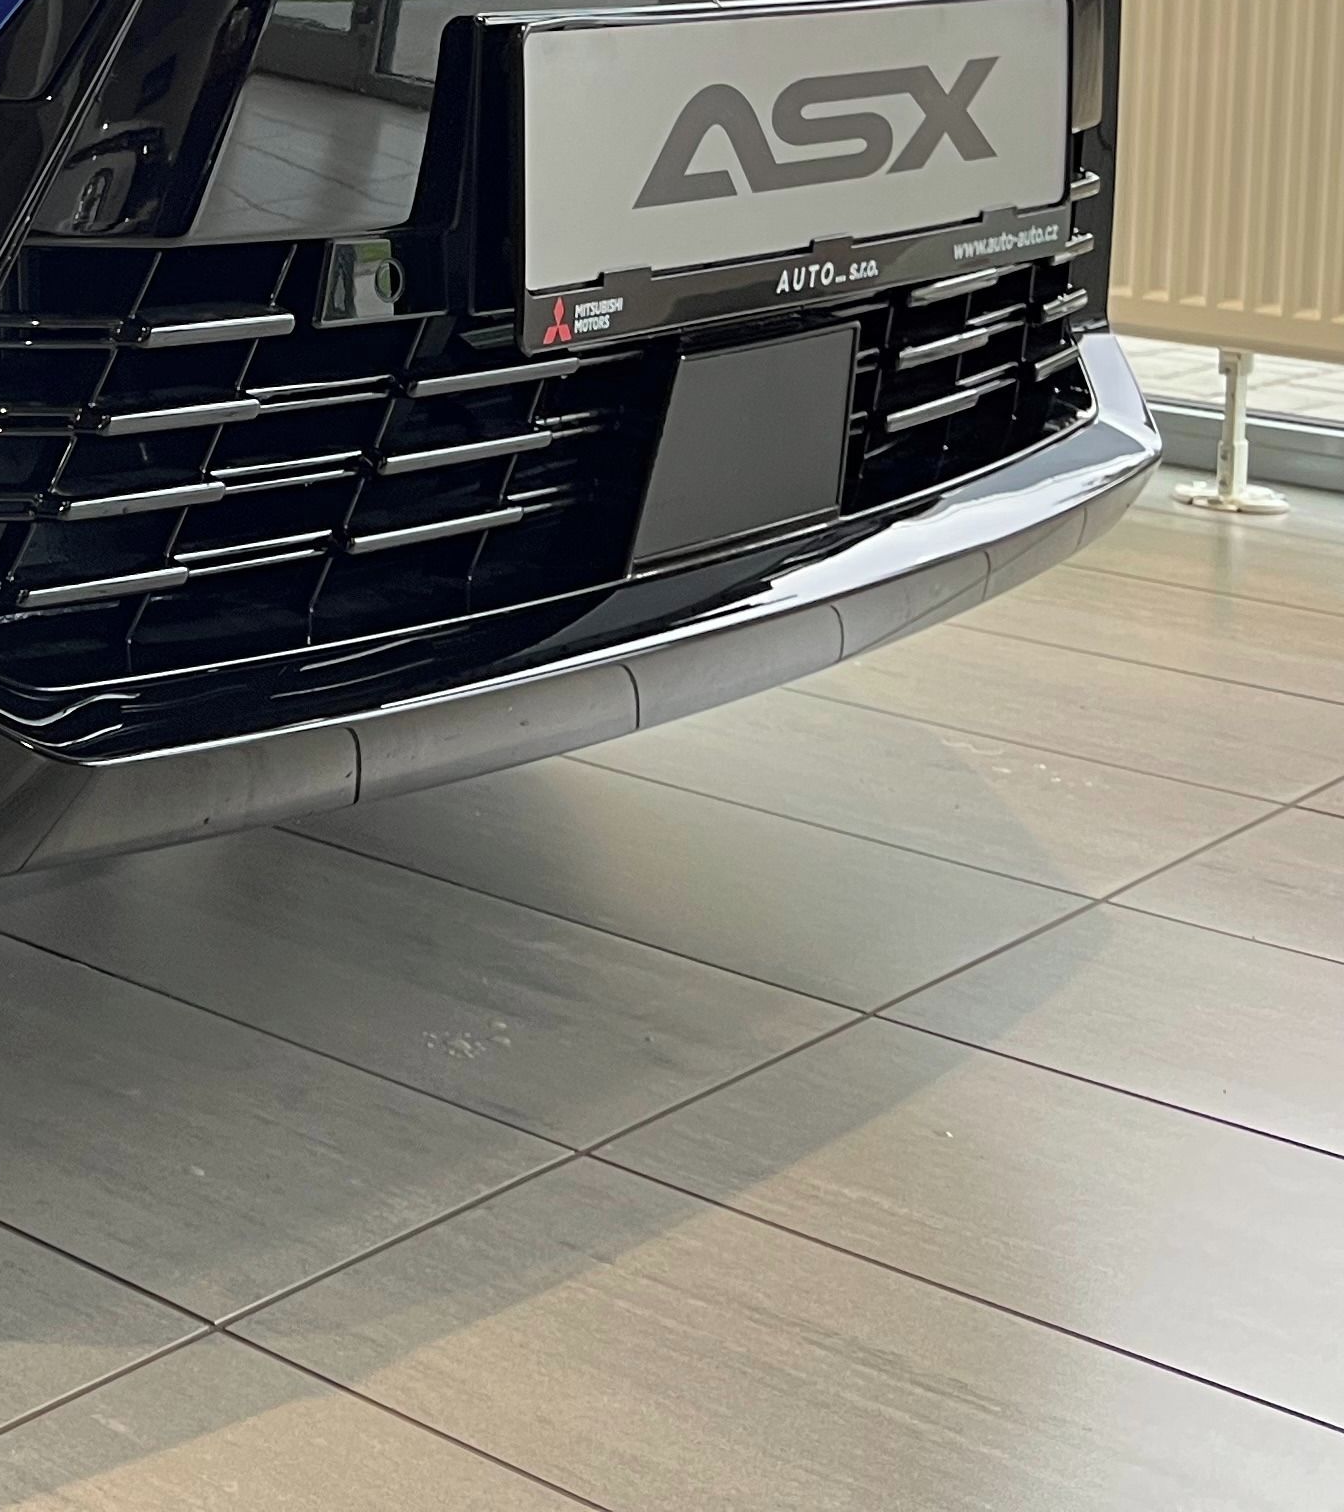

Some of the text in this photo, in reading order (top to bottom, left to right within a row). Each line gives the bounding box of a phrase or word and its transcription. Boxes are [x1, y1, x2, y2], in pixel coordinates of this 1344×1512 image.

[631, 55, 1001, 209] ASX
[953, 224, 1060, 261] www.auto-auto.cz
[574, 296, 624, 319] MITSUBISHI
[573, 314, 610, 334] MOTORS
